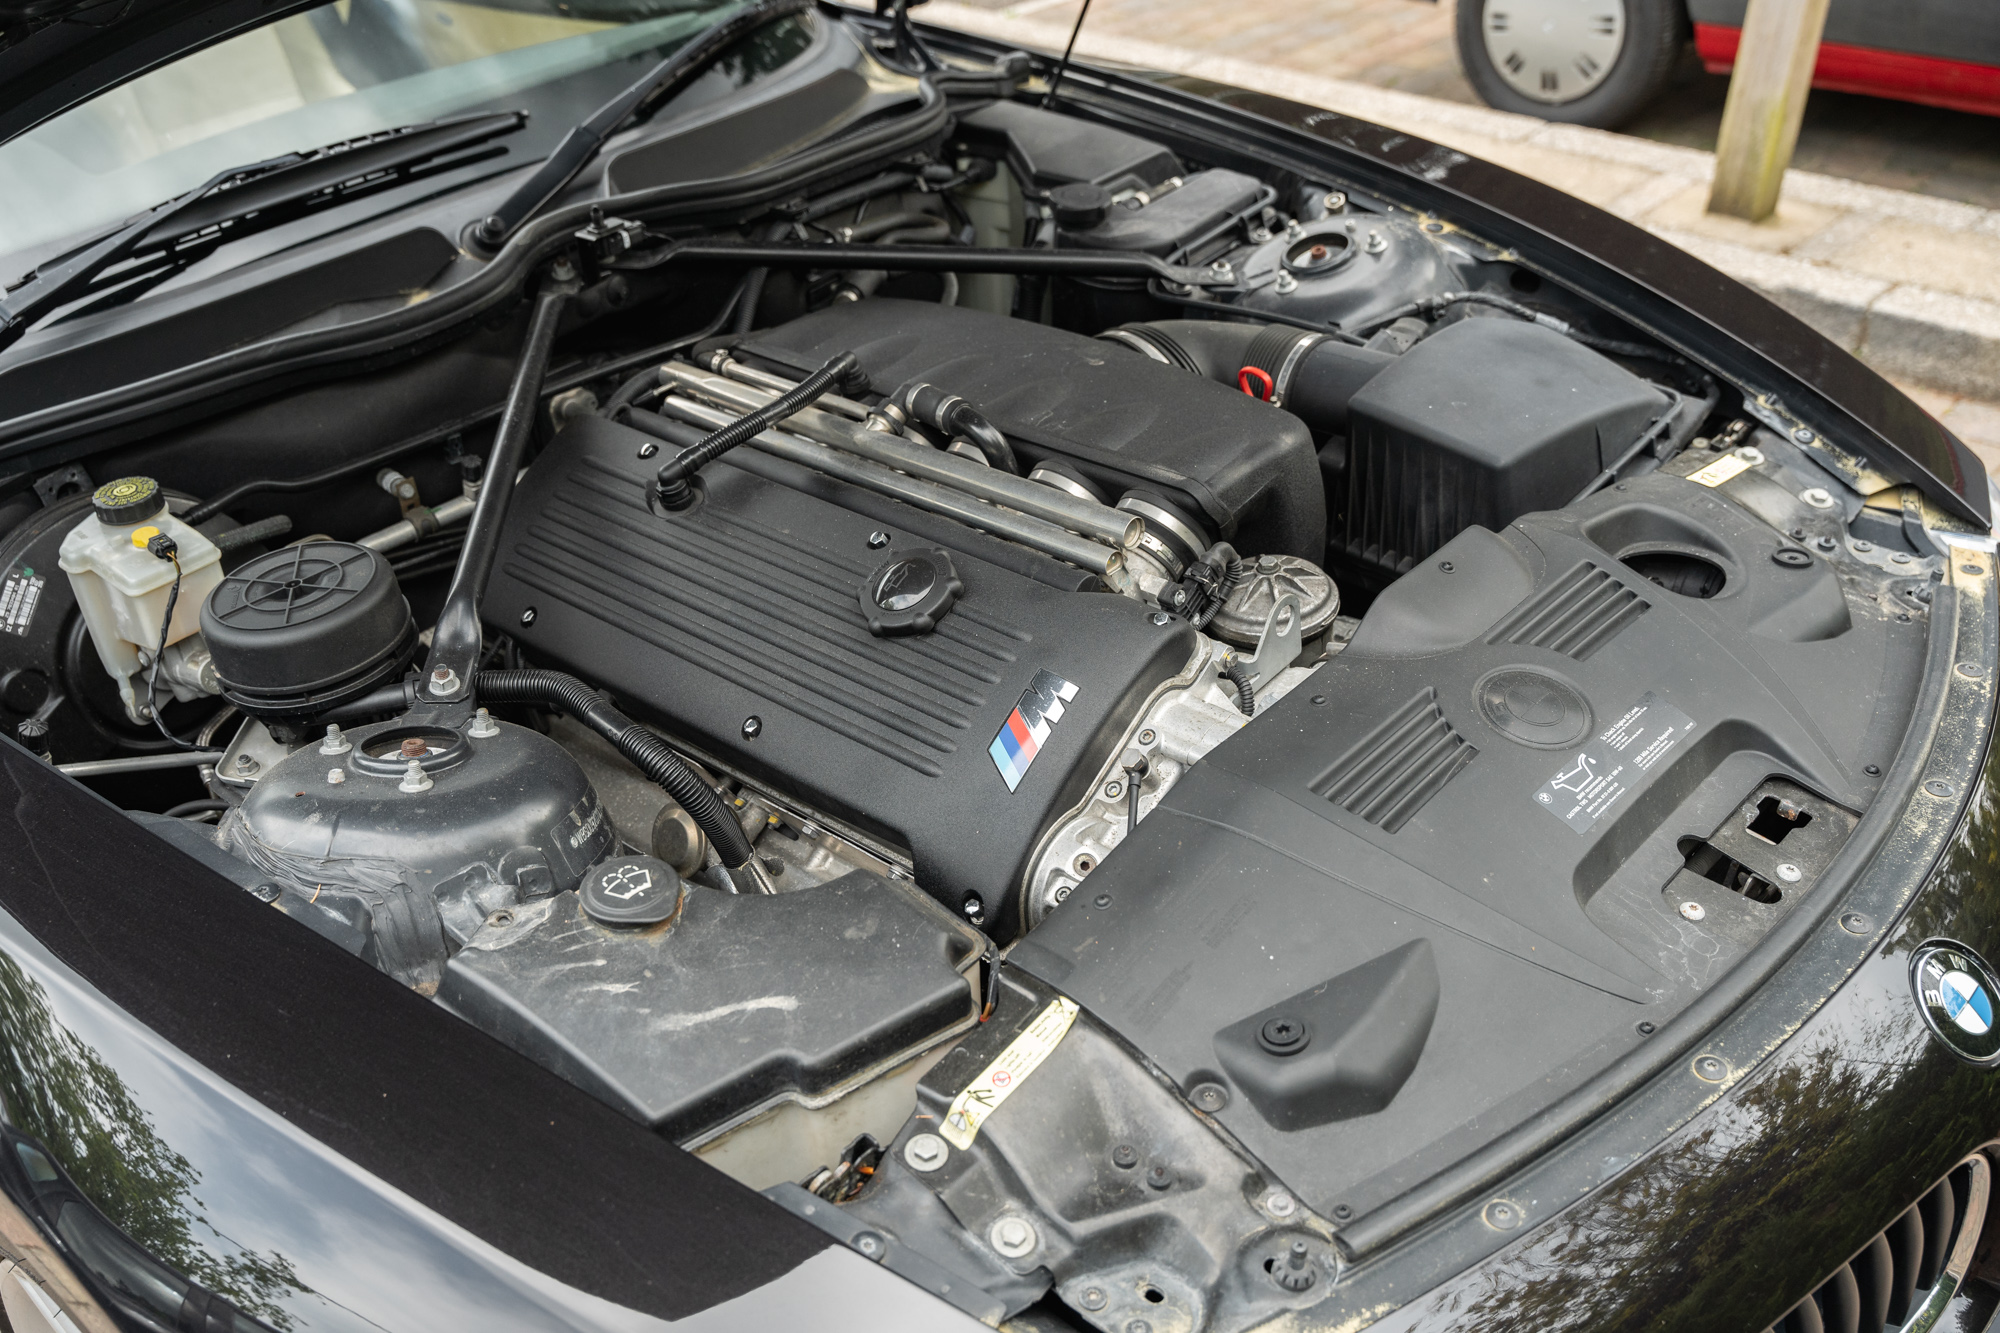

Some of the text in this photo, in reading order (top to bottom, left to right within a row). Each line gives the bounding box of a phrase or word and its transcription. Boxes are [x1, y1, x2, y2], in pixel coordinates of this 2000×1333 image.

[1604, 727, 1616, 737] Check
[1613, 718, 1627, 729] Engine
[1640, 749, 1650, 757] Mile
[1647, 739, 1660, 751] Service
[1566, 805, 1582, 819] CASTROL
[1579, 798, 1588, 807] TWS
[1586, 780, 1608, 799] MOTORSPORT
[1576, 775, 1603, 800] BMW recommends
[1925, 953, 1968, 1007] BMW
